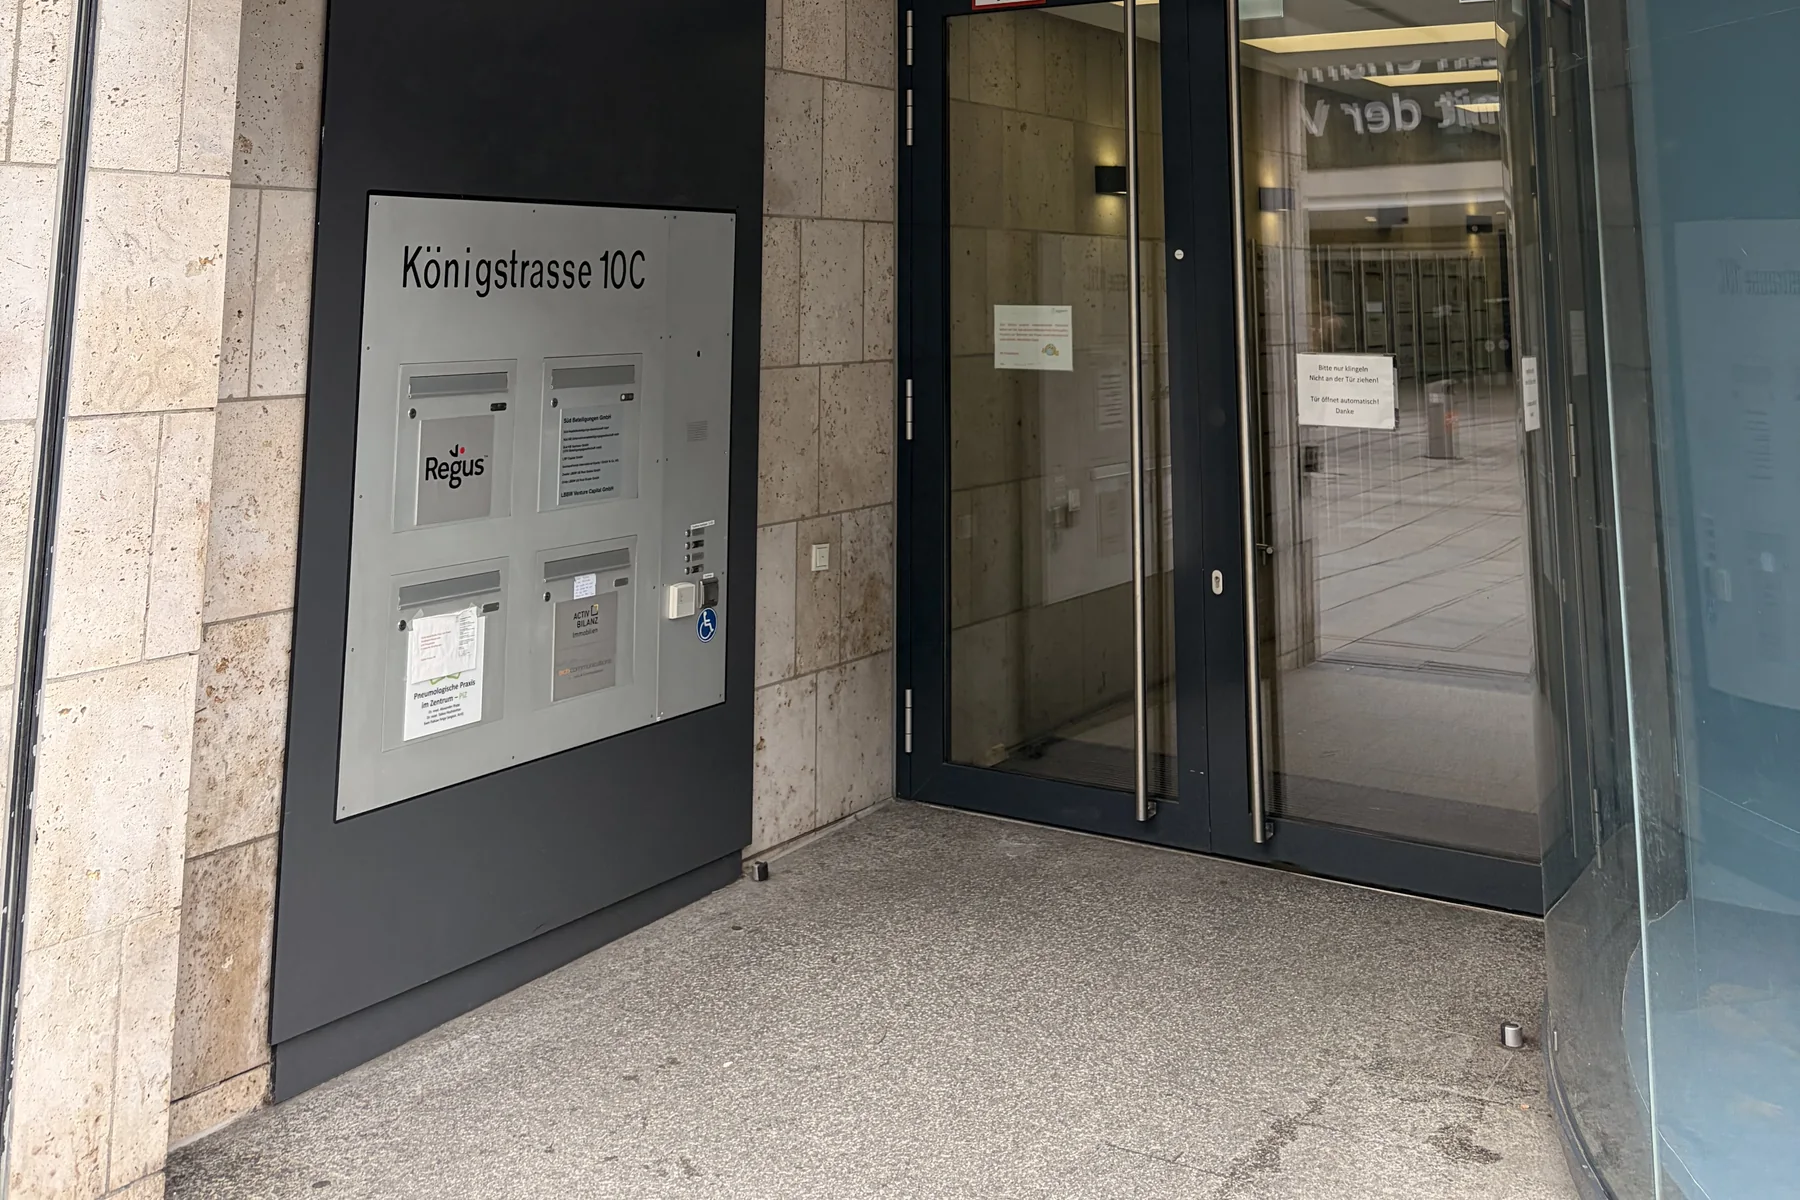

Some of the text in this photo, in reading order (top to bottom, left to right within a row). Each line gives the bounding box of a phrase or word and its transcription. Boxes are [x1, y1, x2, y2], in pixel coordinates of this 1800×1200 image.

[402, 245, 646, 298] Königstrasse 10C
[1318, 364, 1332, 372] Bitte
[1344, 365, 1369, 374] klingeln
[1310, 395, 1320, 403] Tür
[1321, 396, 1339, 404] öffnet
[1335, 407, 1355, 415] Danke
[425, 454, 485, 490] Regus
[573, 610, 590, 620] ACTIV
[577, 616, 599, 629] BILANZ
[413, 679, 476, 700] Pneumologische Praxis
[421, 701, 429, 709] im
[430, 696, 454, 707] Zentrum
